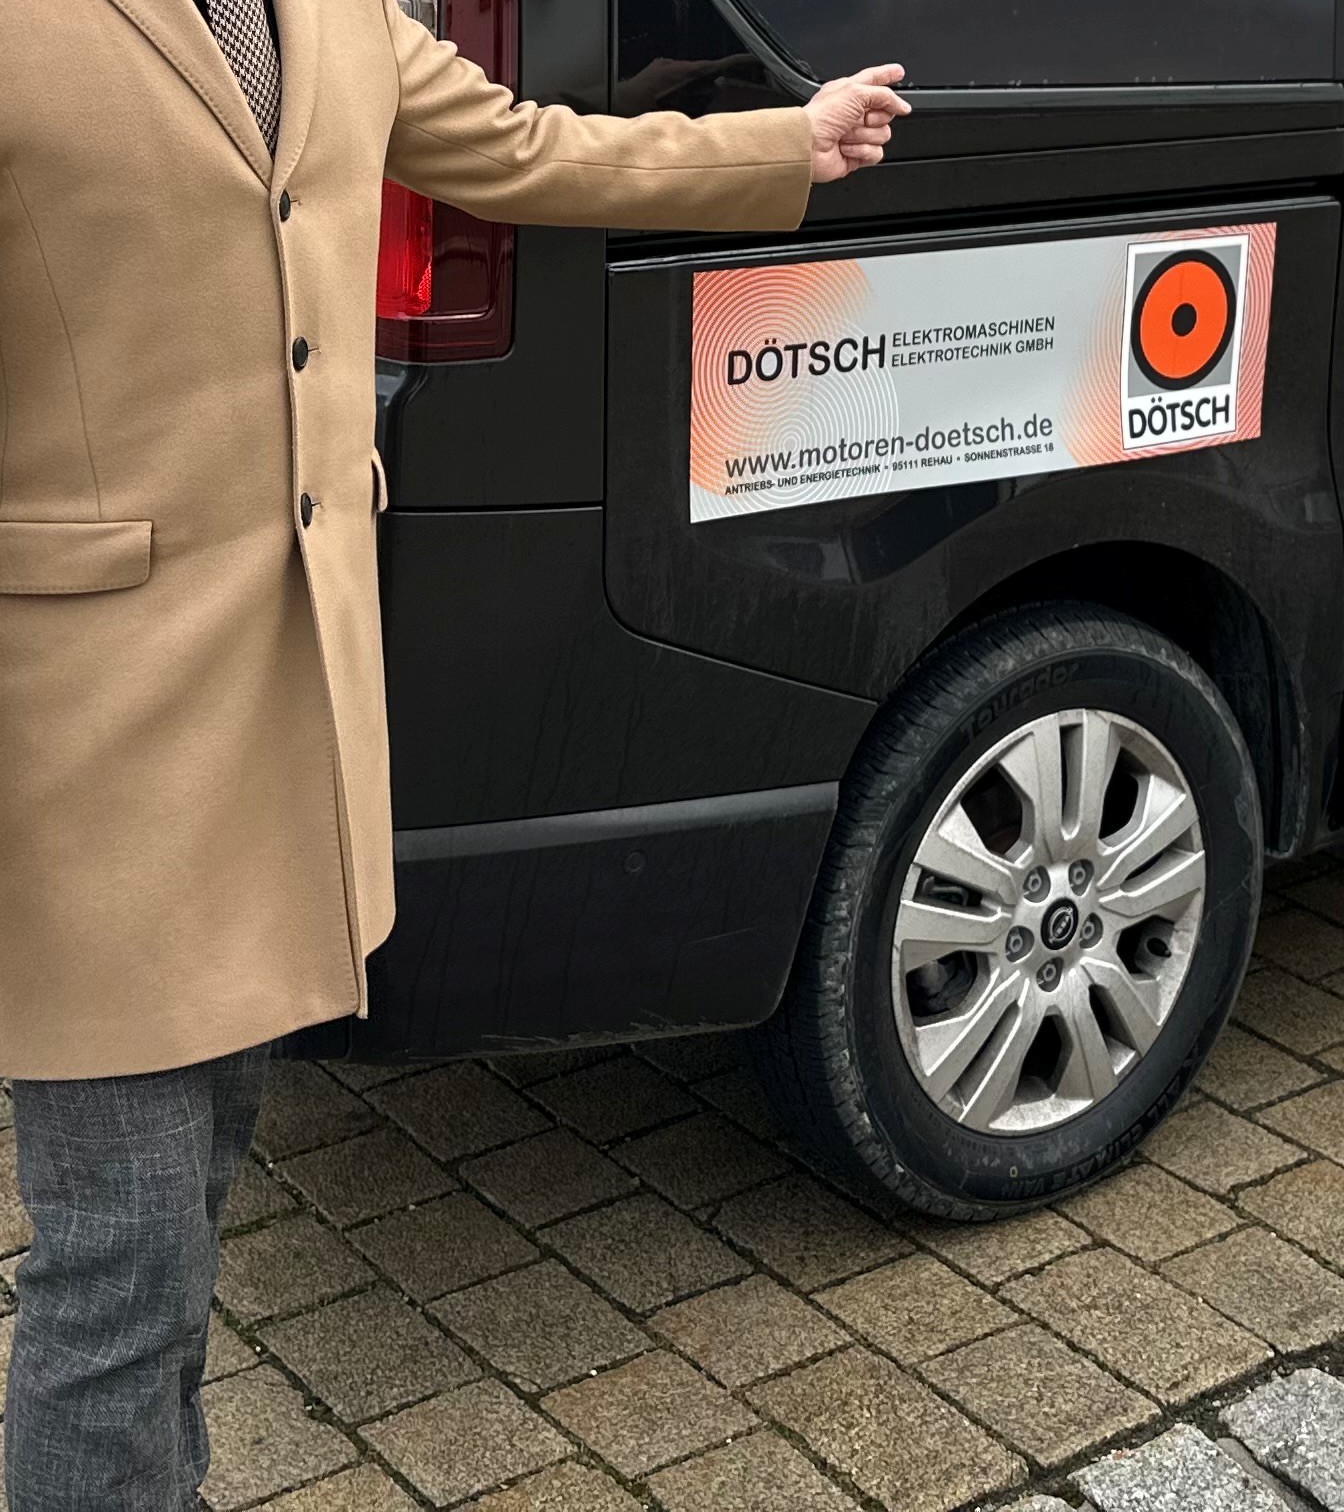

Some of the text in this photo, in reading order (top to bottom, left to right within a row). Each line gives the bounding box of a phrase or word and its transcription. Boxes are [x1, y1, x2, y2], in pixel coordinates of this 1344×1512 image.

[891, 337, 1054, 367] ELEKTROTECHNIK GMBH
[892, 316, 1056, 348] ELEKTROMASCHINEN
[728, 334, 886, 385] DÖTSCH
[1127, 394, 1231, 439] DÖTSCH
[724, 479, 775, 495] ANTRIEBS-
[777, 475, 798, 487] UND
[800, 464, 881, 484] ENERGIETECHNIK
[892, 460, 919, 471] 95111
[920, 455, 953, 468] REHAU
[964, 444, 1042, 462] SONNENSTRASSE
[725, 413, 1053, 479] www.motoren-doetsch.de
